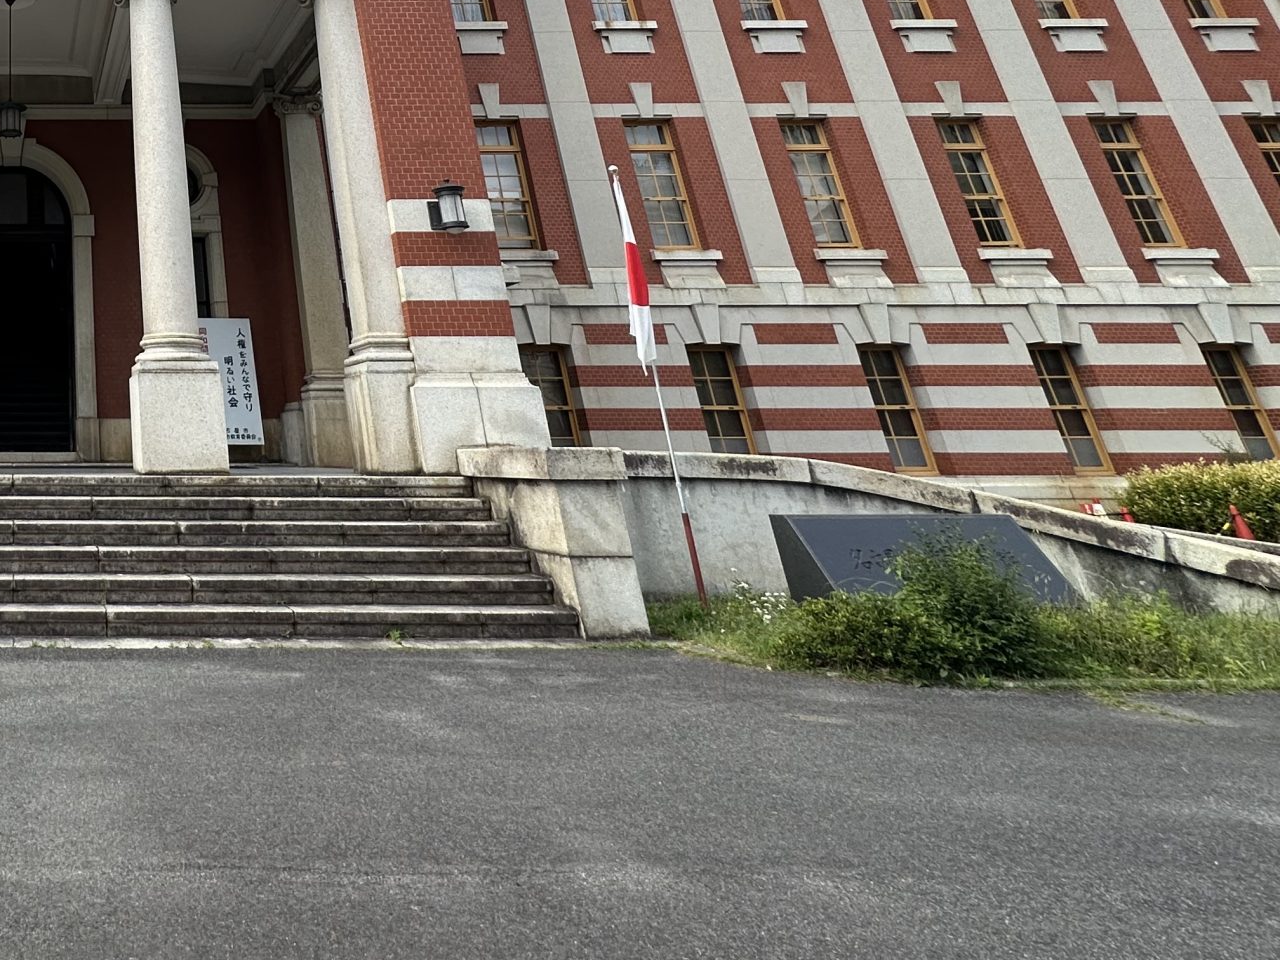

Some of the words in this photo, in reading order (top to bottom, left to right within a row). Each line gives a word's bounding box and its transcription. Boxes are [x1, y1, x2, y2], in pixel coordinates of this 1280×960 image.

[224, 356, 239, 408] 明るい社会
[236, 327, 253, 412] 人権をみんなで守り
